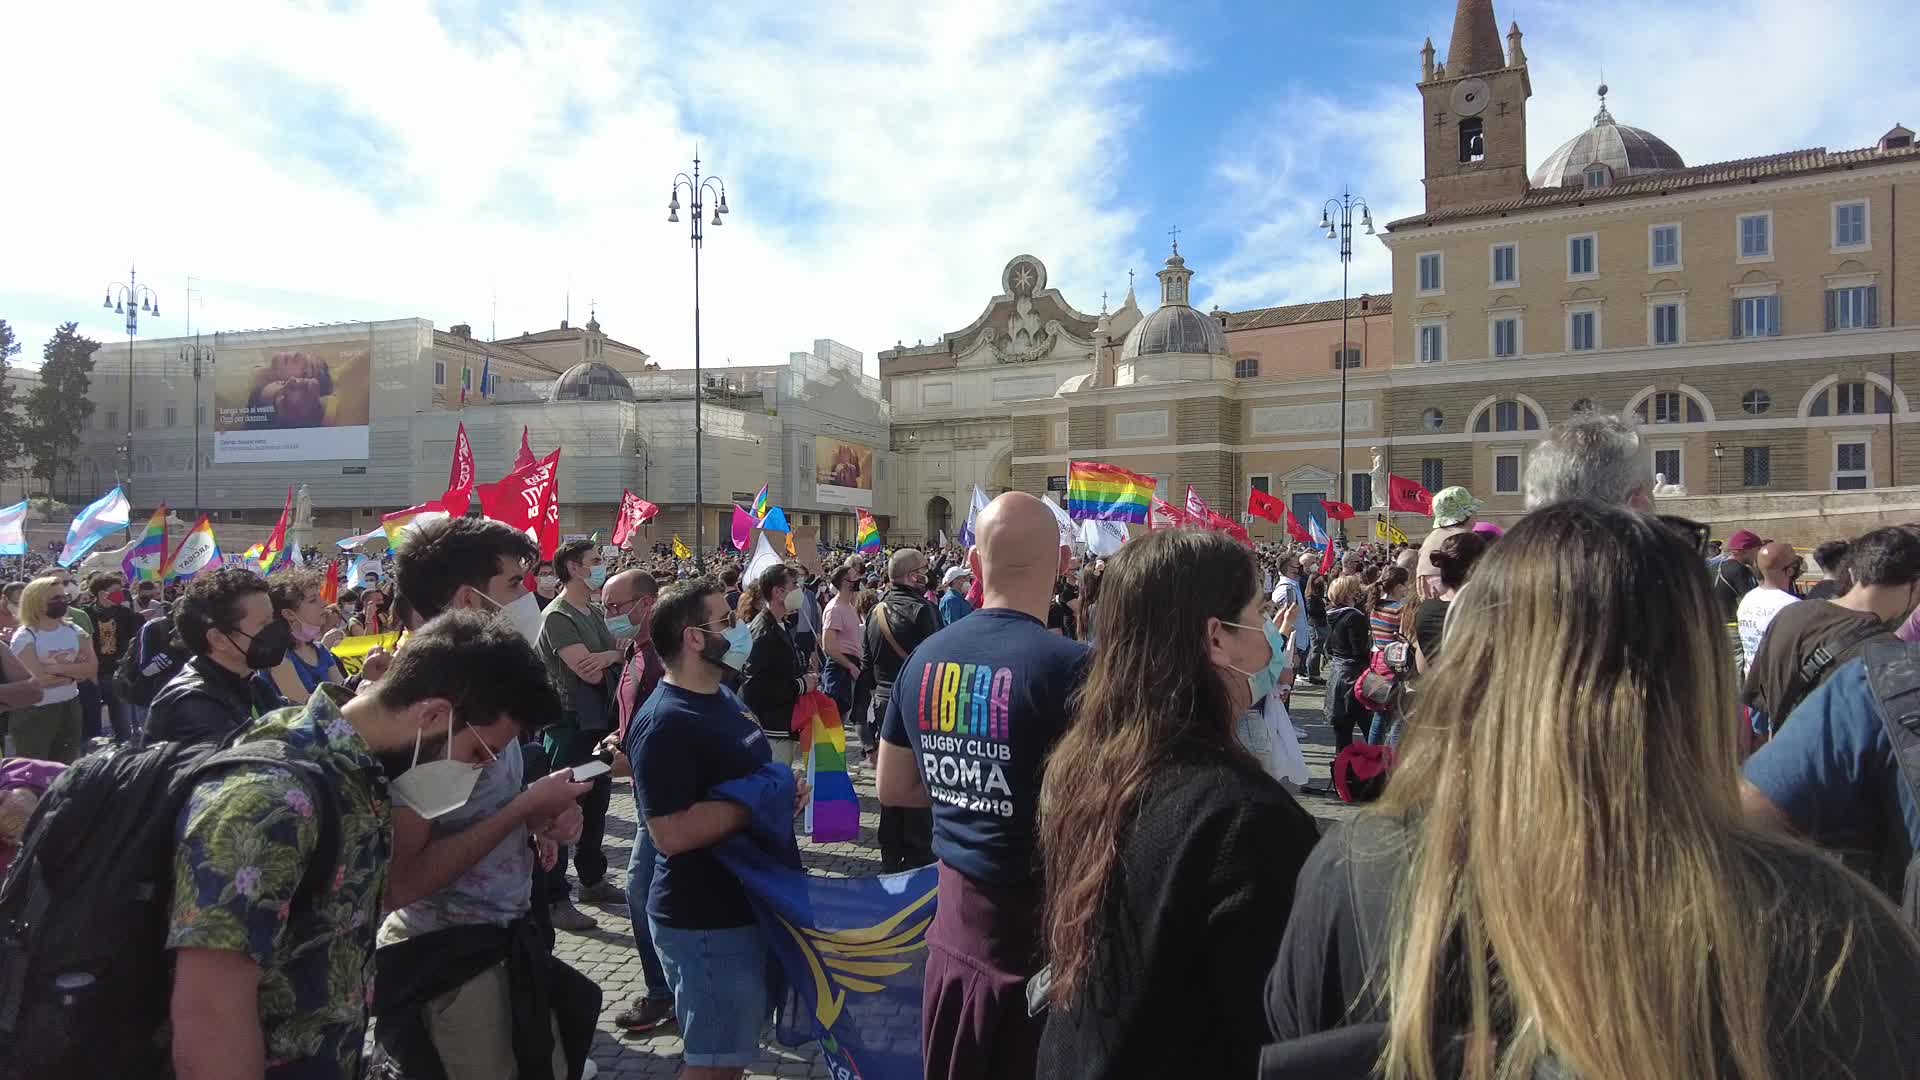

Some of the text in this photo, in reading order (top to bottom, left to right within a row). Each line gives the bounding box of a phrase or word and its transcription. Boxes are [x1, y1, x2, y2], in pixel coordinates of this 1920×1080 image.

[918, 662, 1013, 739] LIBERA
[920, 734, 1012, 761] RUGBY CLUB
[923, 752, 1013, 797] ROMA
[930, 785, 1014, 818] PRIDE 2019
